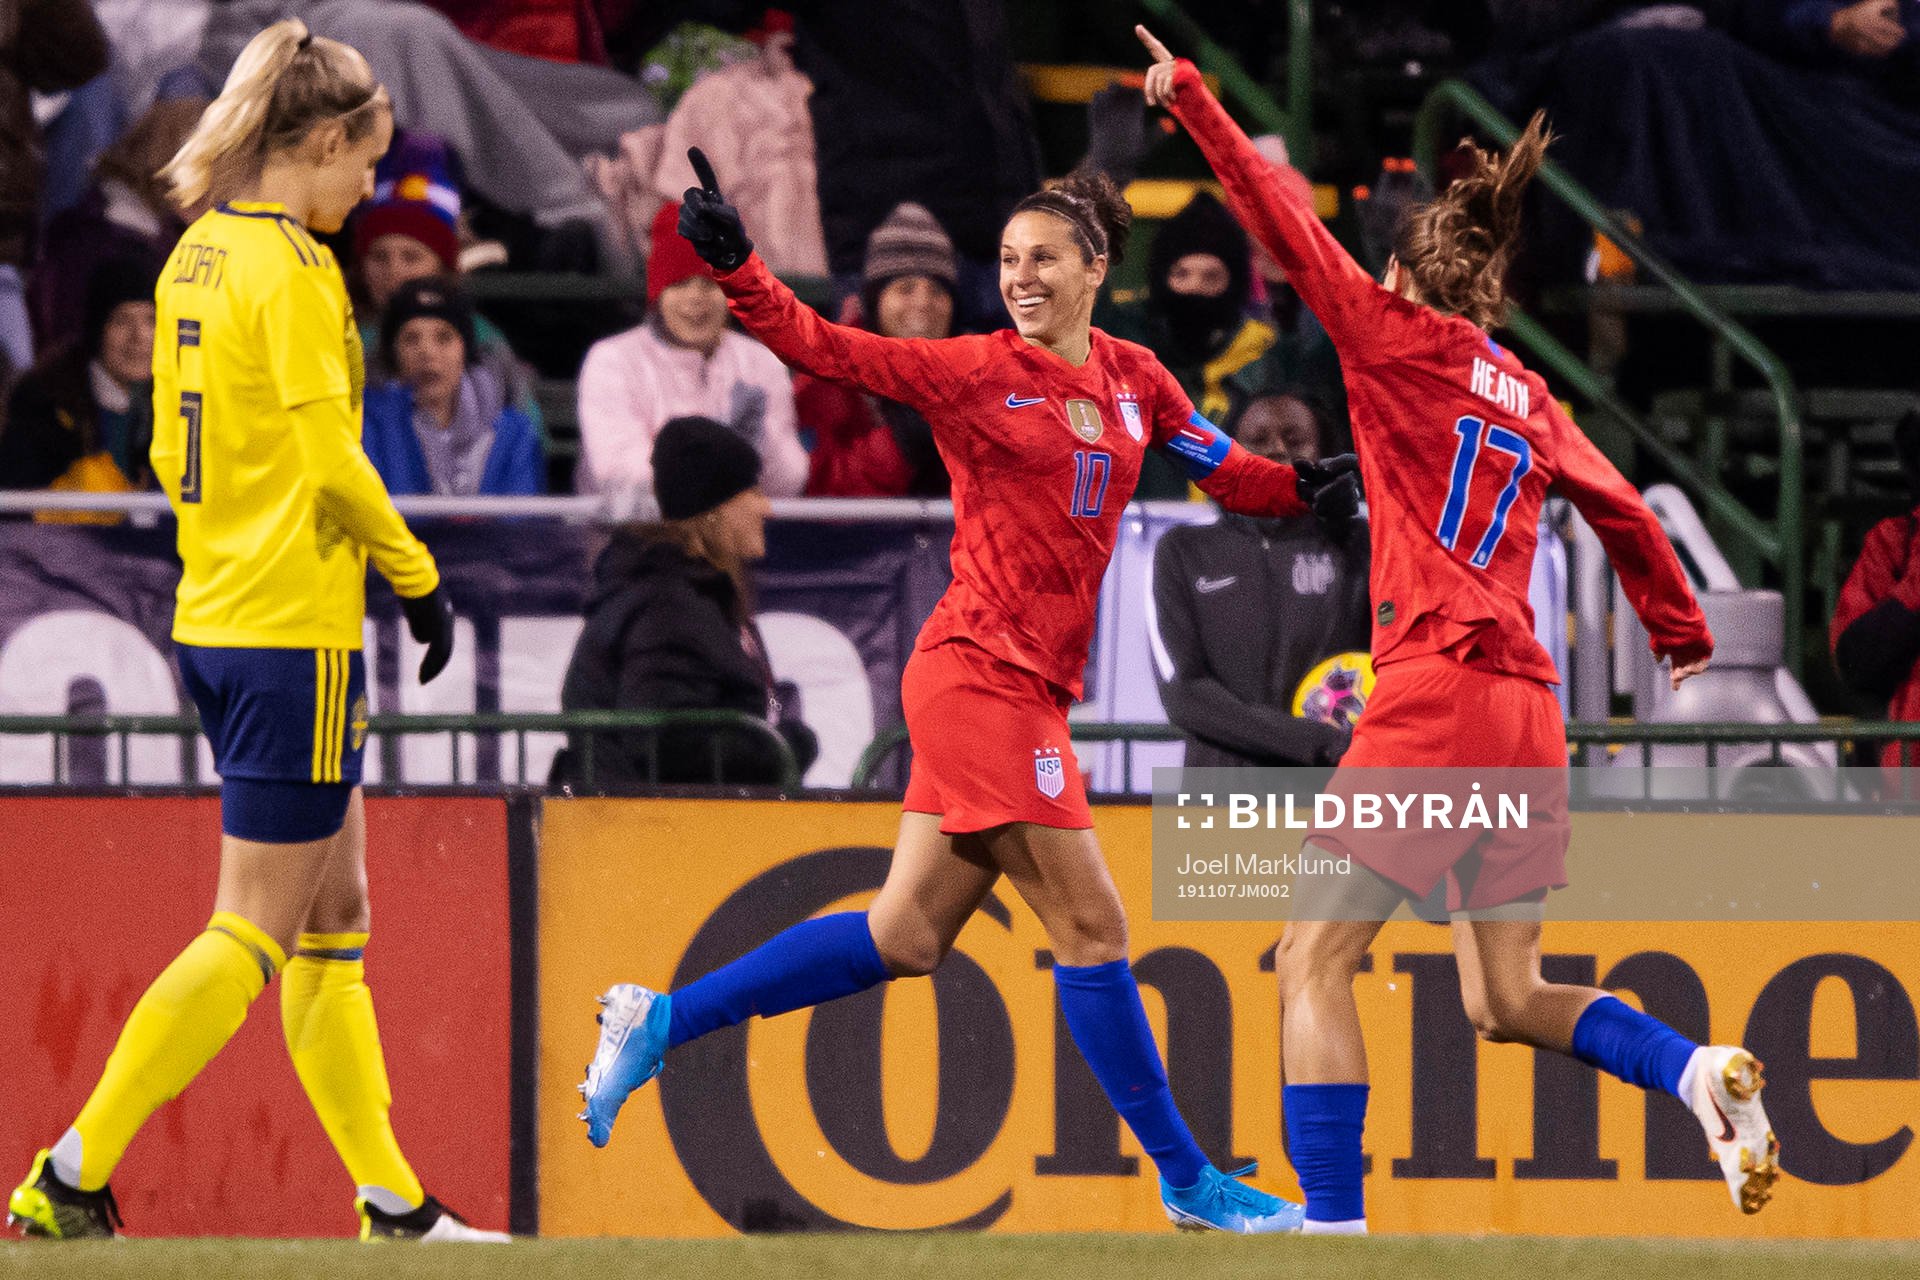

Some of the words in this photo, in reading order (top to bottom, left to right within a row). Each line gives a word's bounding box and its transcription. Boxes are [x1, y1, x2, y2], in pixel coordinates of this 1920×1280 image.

[1470, 356, 1530, 420] HEATH
[1070, 450, 1111, 518] 10
[1436, 414, 1534, 570] 17
[657, 846, 1920, 1234] Conine
